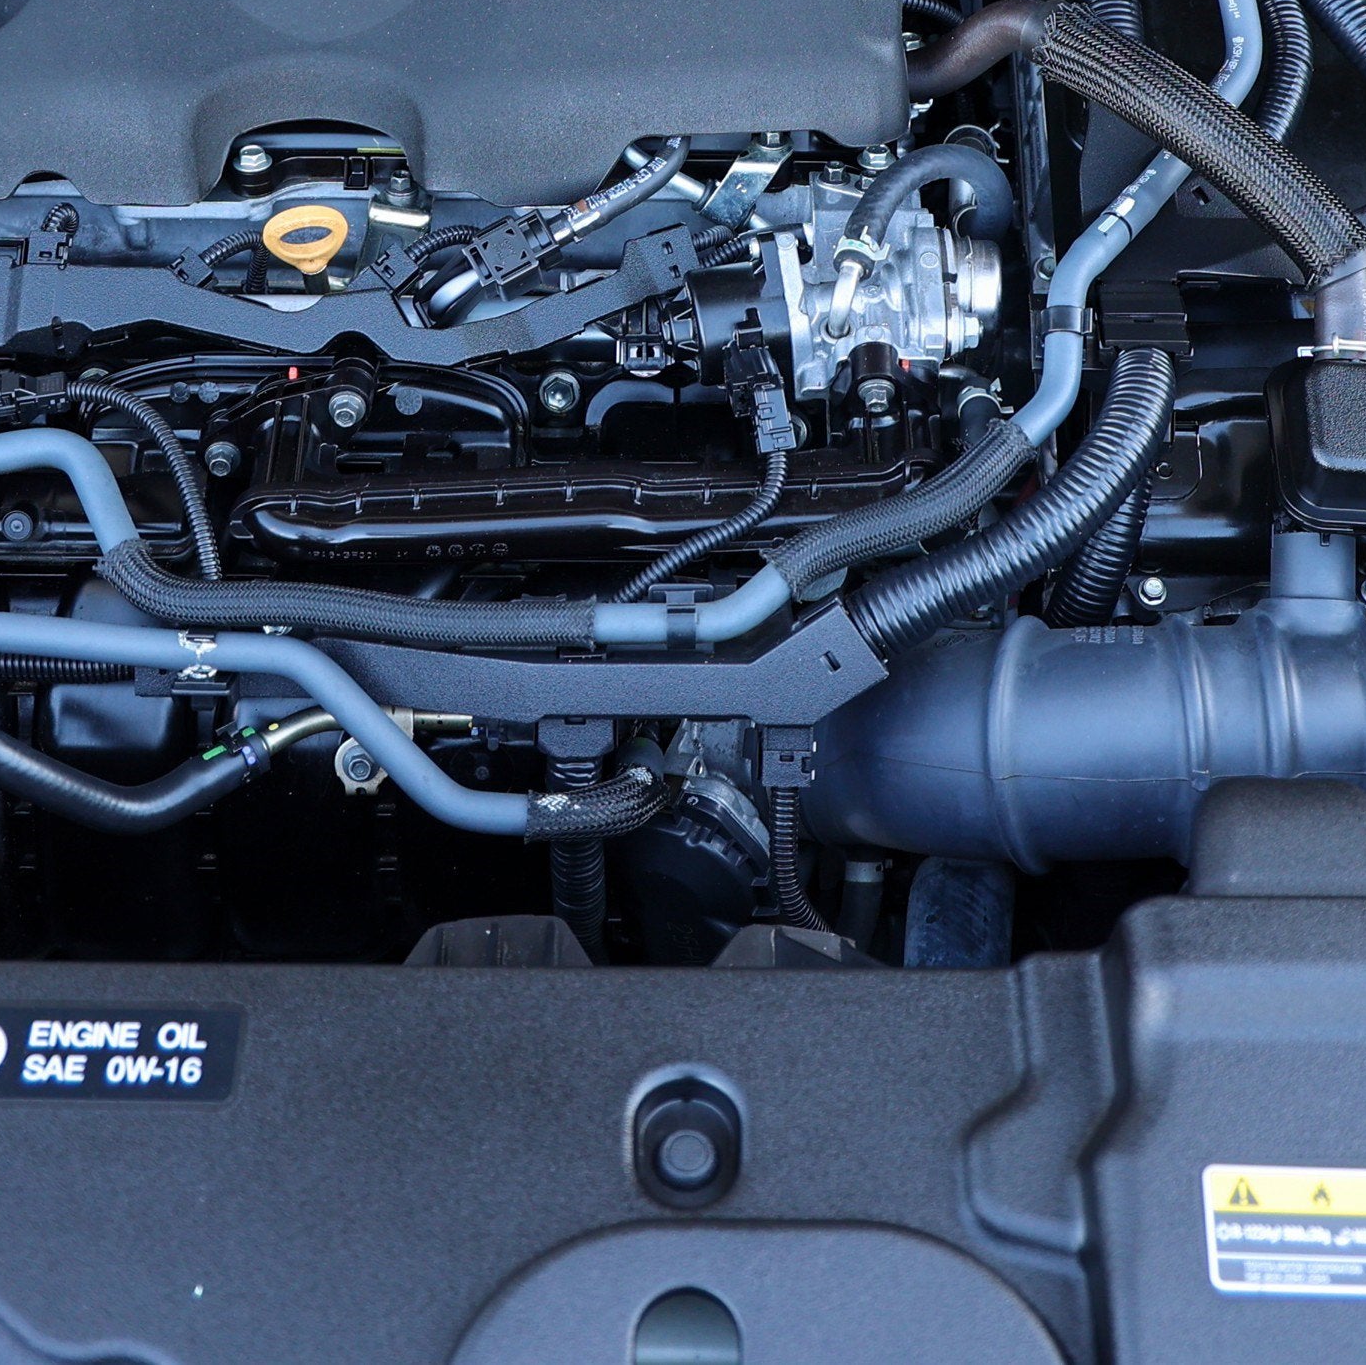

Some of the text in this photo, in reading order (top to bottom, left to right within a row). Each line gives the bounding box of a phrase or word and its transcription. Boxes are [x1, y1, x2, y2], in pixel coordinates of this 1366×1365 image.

[27, 1020, 207, 1050] ENGINE OIL
[21, 1054, 203, 1084] SAE 0W-16
